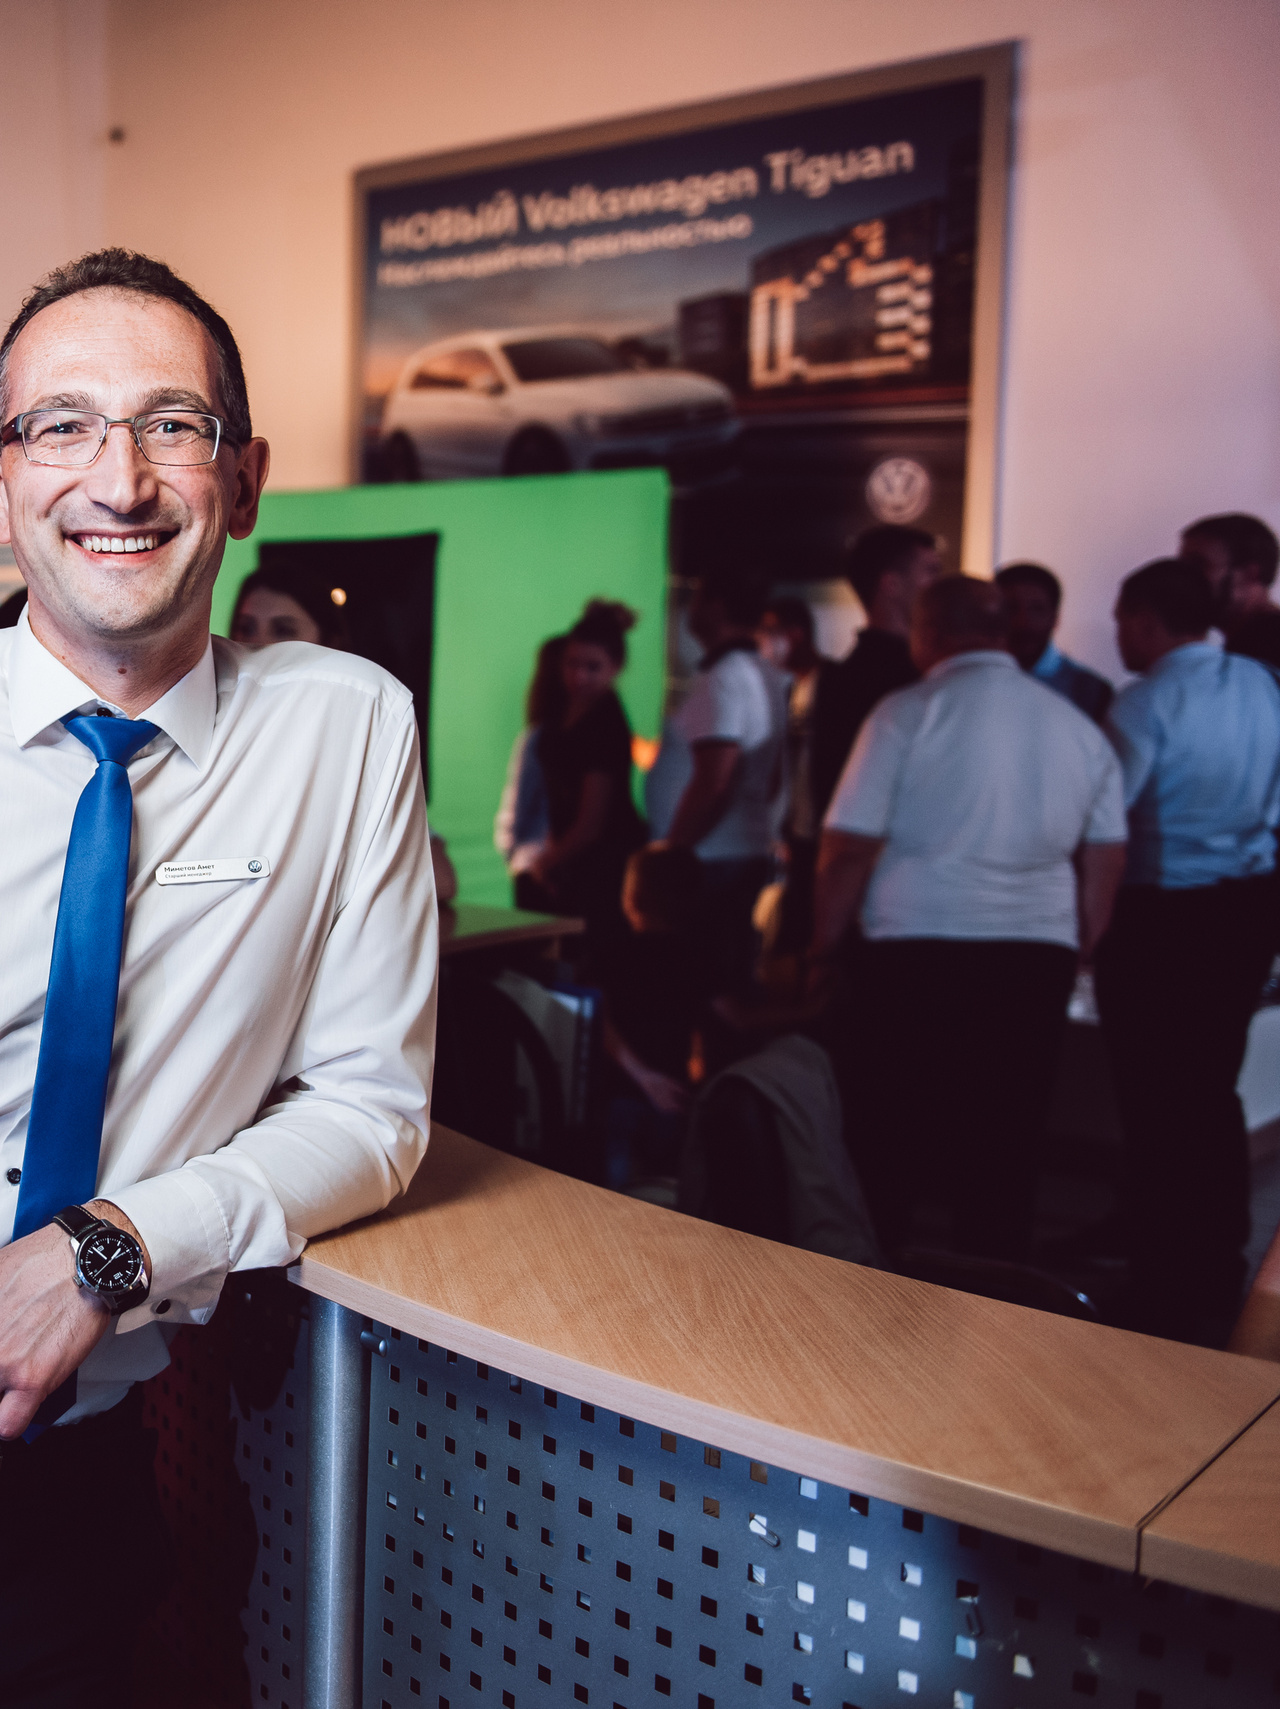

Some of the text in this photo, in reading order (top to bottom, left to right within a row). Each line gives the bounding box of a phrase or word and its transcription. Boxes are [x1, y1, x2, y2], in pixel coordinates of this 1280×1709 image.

[379, 140, 915, 253] НОВЫЙ Volkswagen Tiguan
